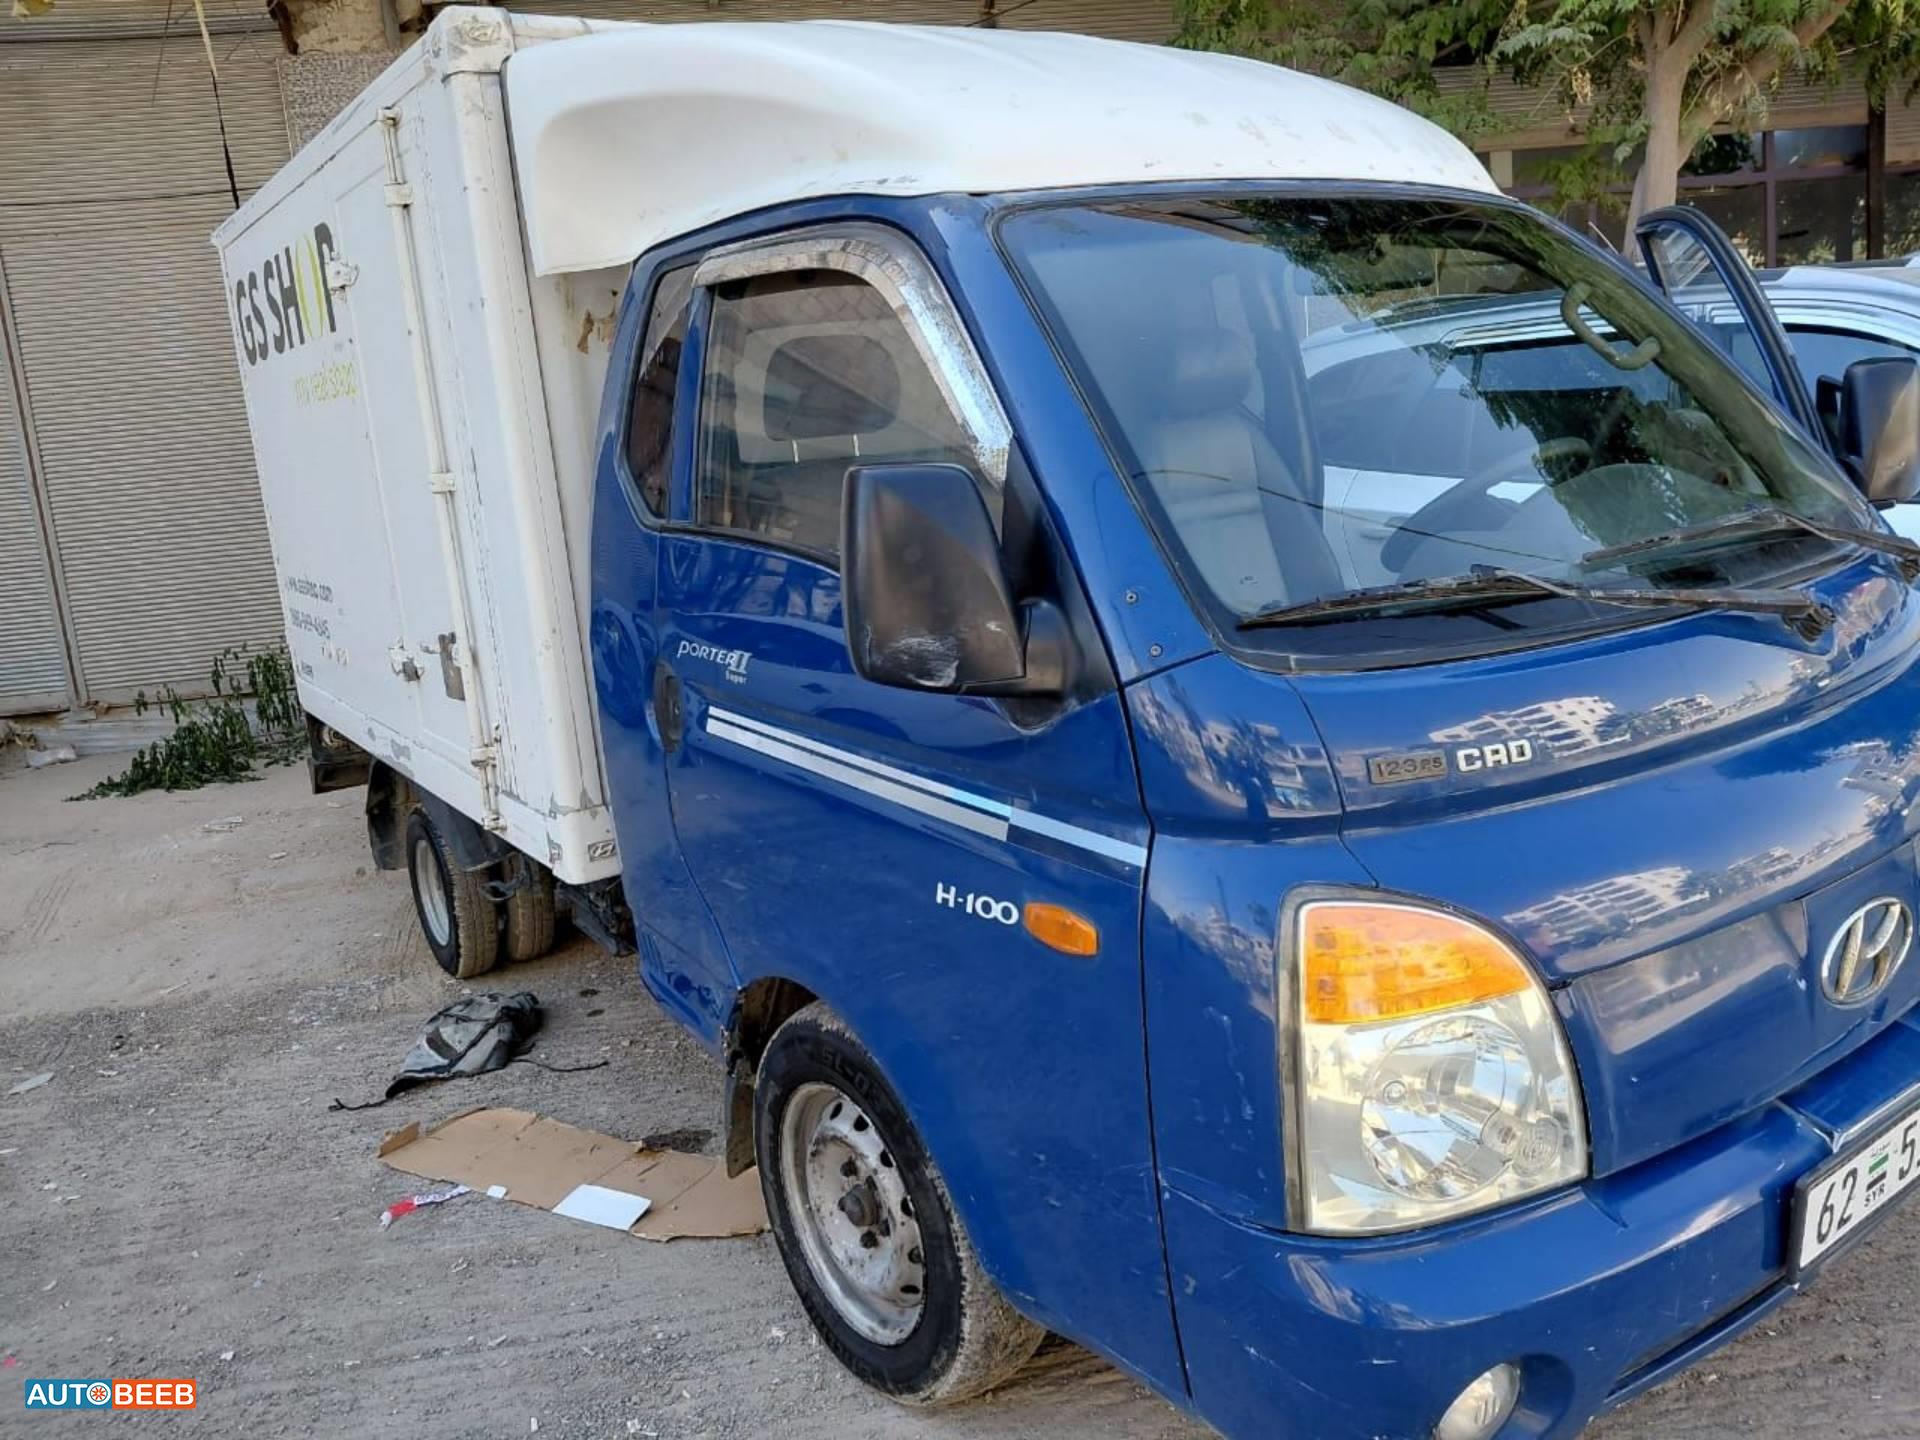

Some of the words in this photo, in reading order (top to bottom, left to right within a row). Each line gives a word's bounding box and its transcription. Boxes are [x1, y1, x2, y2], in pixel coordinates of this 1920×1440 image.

[236, 270, 269, 367] GS
[263, 222, 337, 355] SHOP
[676, 640, 735, 667] PORTER
[935, 881, 1020, 925] H-100
[1816, 1166, 1858, 1245] 62
[1898, 1119, 1920, 1181] 5
